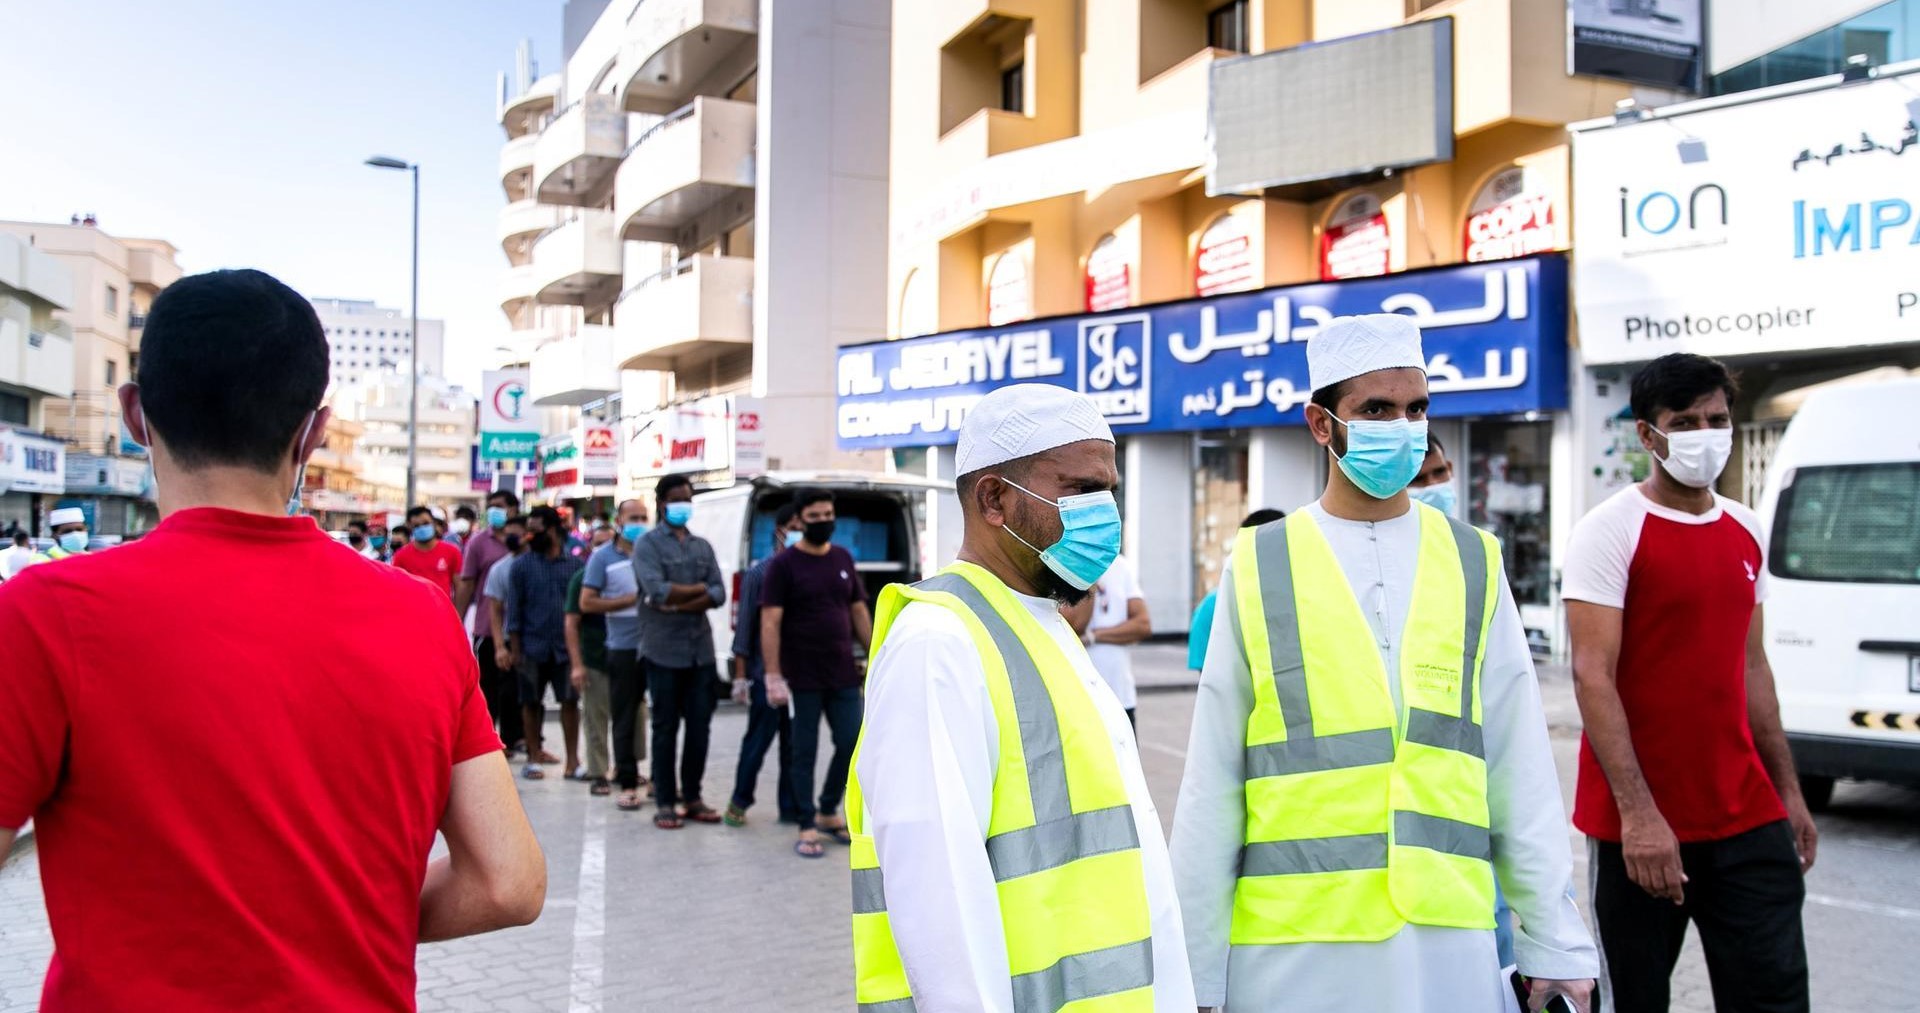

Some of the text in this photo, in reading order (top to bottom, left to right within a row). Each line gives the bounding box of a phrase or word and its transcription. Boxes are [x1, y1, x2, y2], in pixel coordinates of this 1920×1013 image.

[1469, 196, 1553, 243] COPY
[1620, 182, 1727, 238] ion
[1793, 198, 1920, 258] IMP
[1624, 305, 1816, 342] Photocopier
[838, 329, 1064, 396] AL JEDAYEL
[838, 395, 985, 438] COMPUT
[488, 437, 536, 454] Aster
